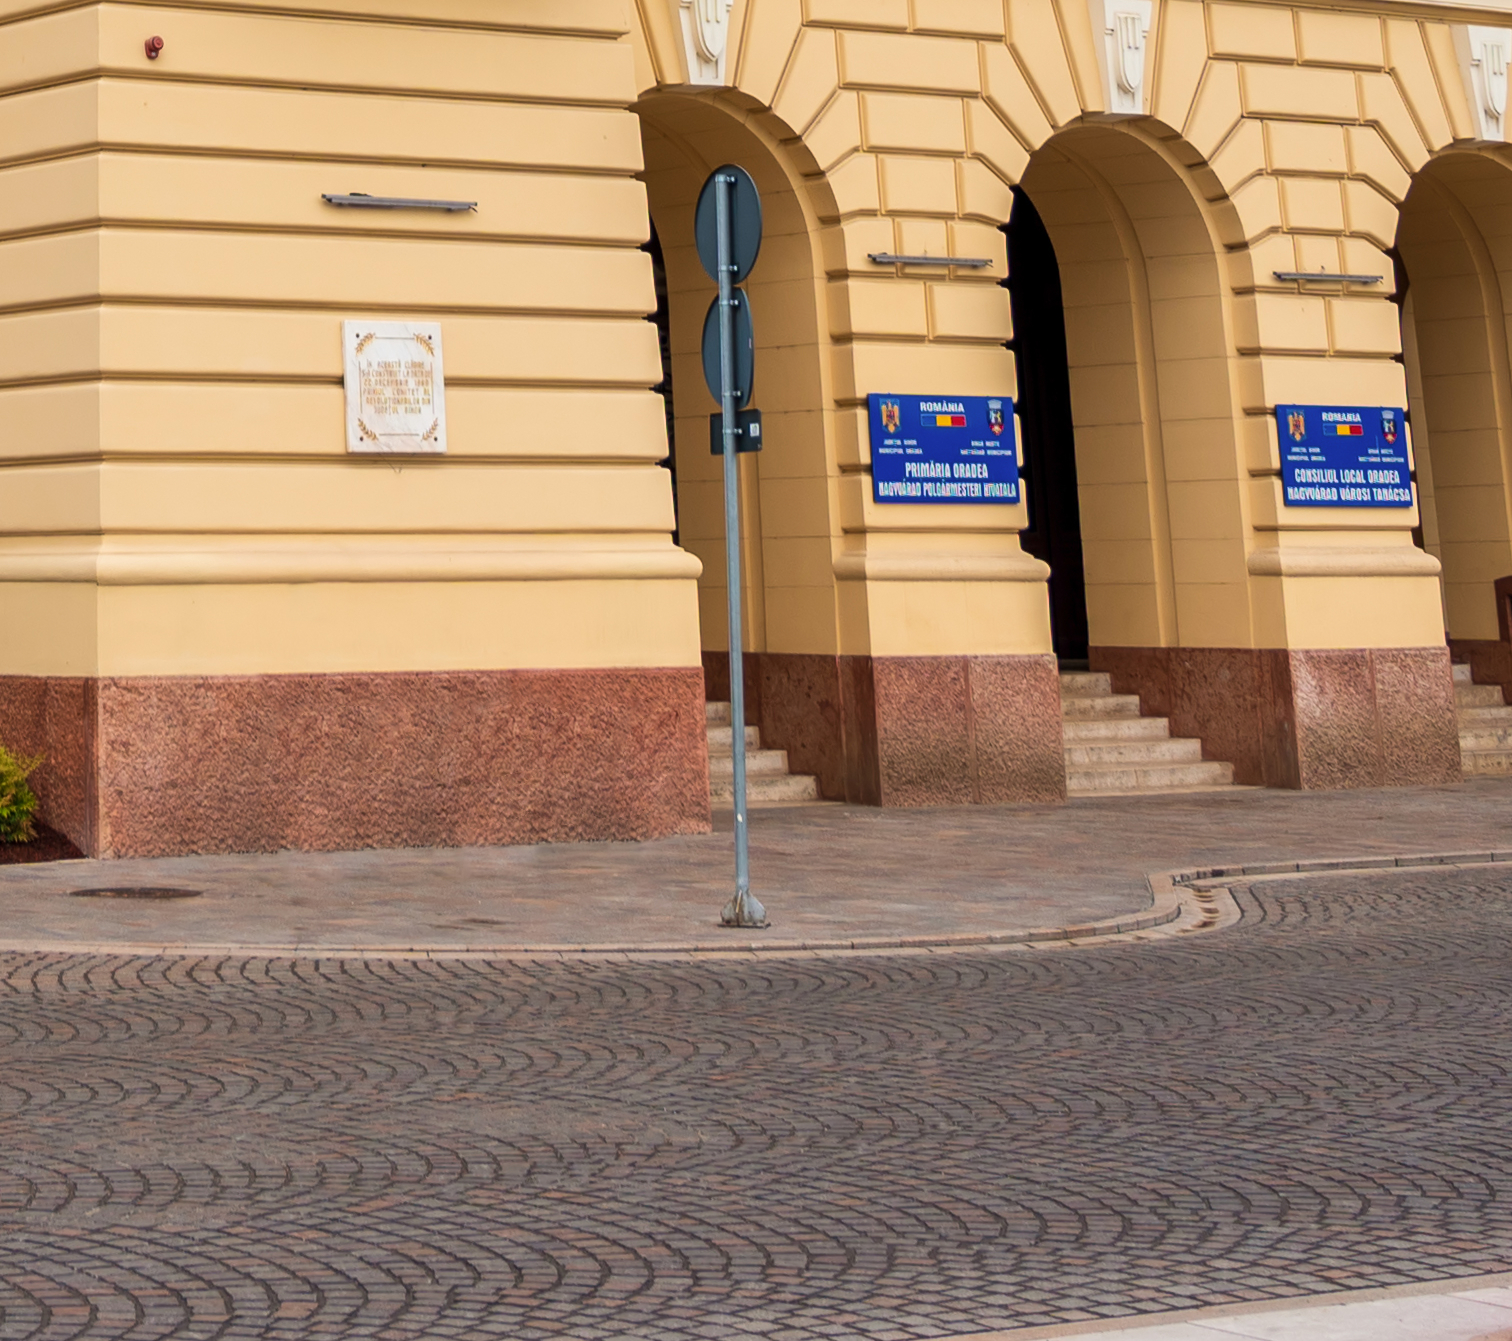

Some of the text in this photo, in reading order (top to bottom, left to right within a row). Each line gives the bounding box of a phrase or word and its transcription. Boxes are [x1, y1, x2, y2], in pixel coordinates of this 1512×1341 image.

[920, 400, 965, 413] ROMÂNIA
[905, 460, 989, 479] PRIMĂRIA ORADEA
[1294, 468, 1400, 484] CONSILIUL LOCAL ORADEA
[1339, 485, 1371, 501] VÁROSI
